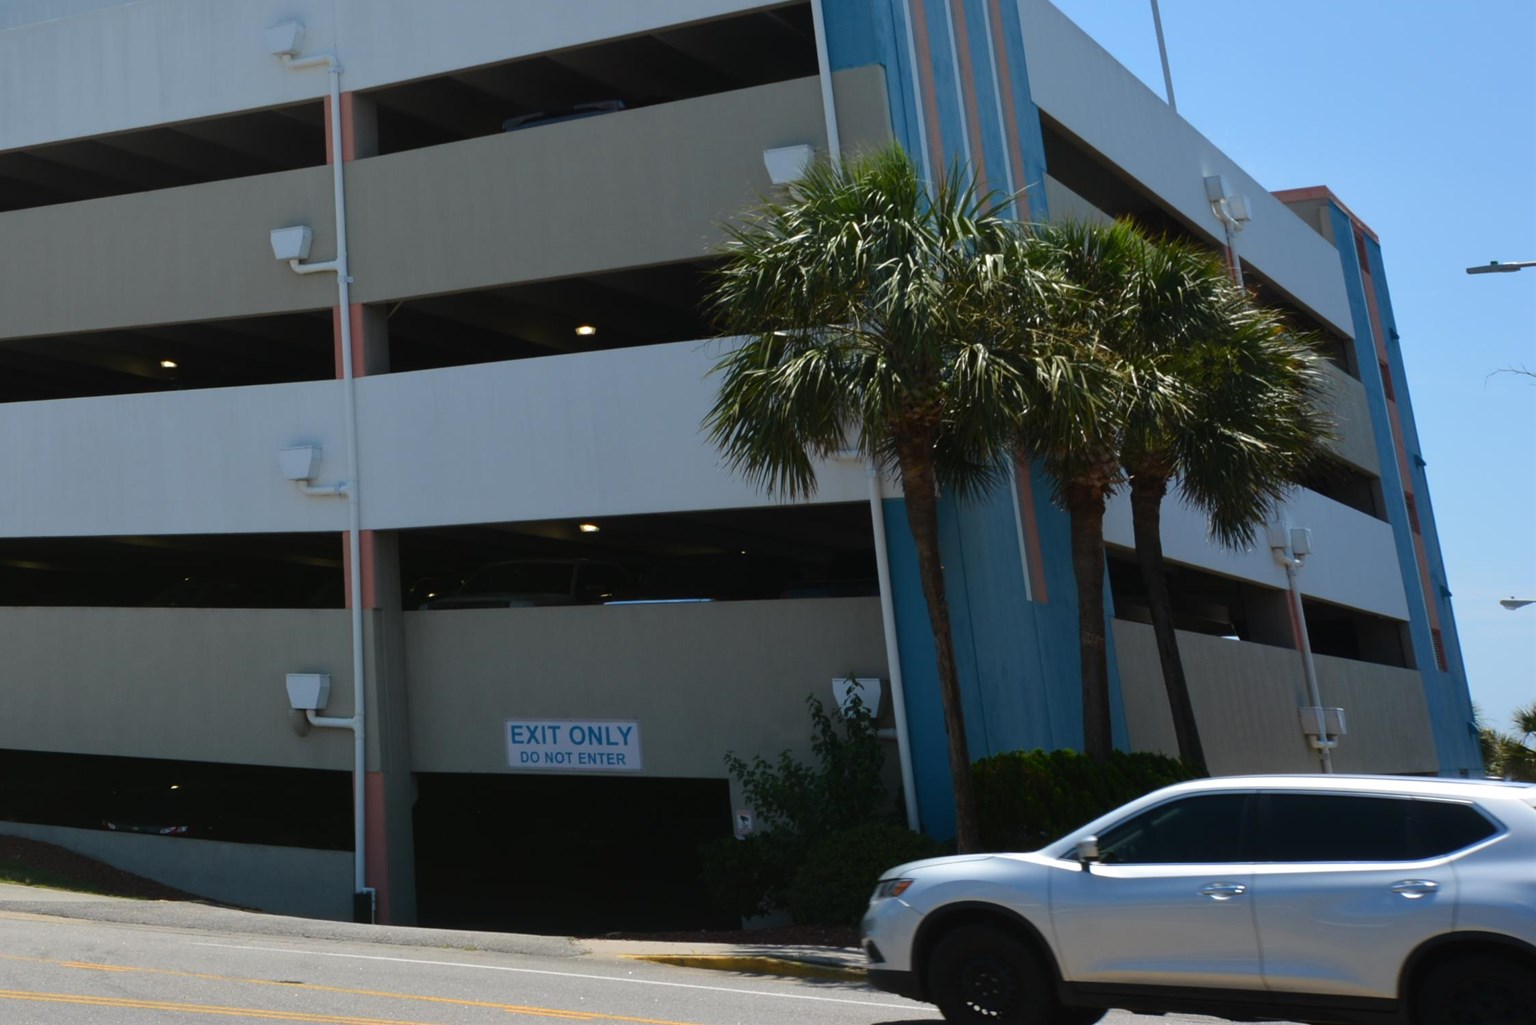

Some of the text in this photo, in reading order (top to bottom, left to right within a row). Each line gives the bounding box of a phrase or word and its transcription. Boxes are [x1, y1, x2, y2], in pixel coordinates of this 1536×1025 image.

[511, 725, 632, 746] EXIT ONLY
[520, 751, 626, 765] DO NOT ENTER
